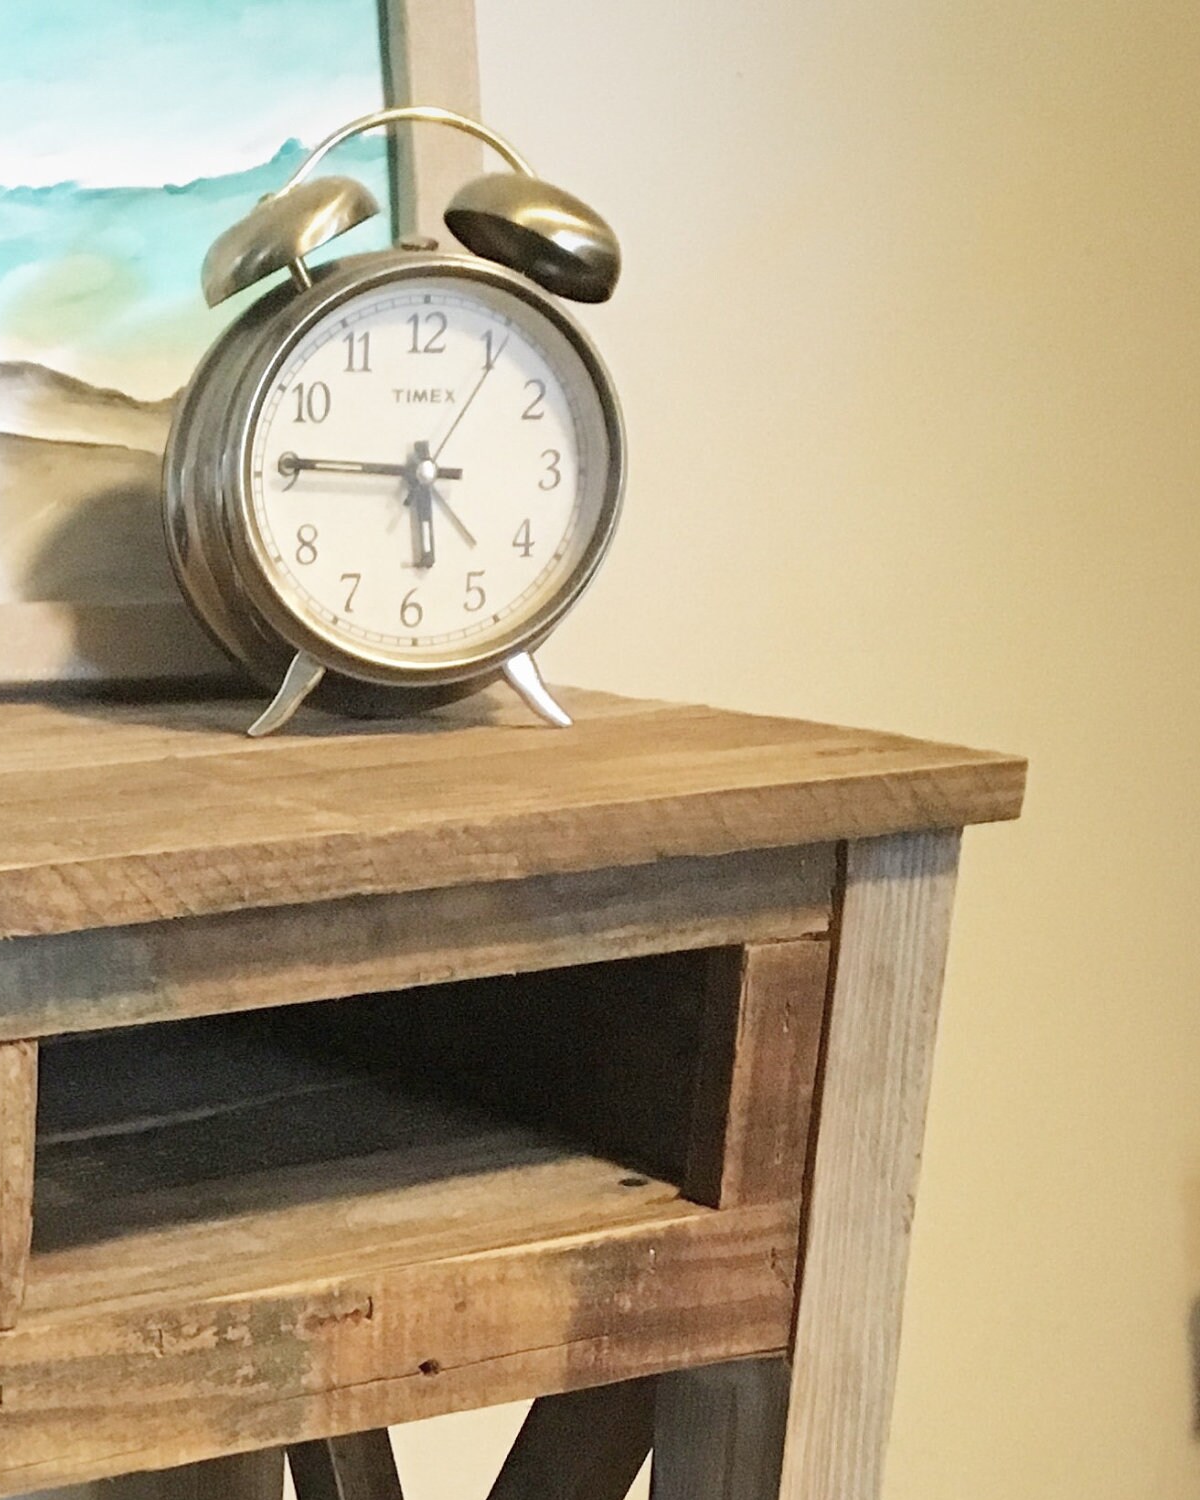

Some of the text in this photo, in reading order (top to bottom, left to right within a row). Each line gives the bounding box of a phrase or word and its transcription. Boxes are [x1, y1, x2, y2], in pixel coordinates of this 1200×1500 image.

[343, 331, 372, 373] 11
[406, 312, 447, 353] 12
[481, 330, 496, 371] 1
[292, 381, 331, 423] 10
[392, 388, 456, 404] TIMEX
[521, 379, 547, 420] 2
[278, 451, 300, 493] 9
[538, 449, 561, 491] 3
[295, 524, 318, 565] 8
[512, 518, 535, 558] 4
[340, 573, 362, 613] 7
[400, 588, 423, 628] 6
[463, 570, 487, 612] 5
